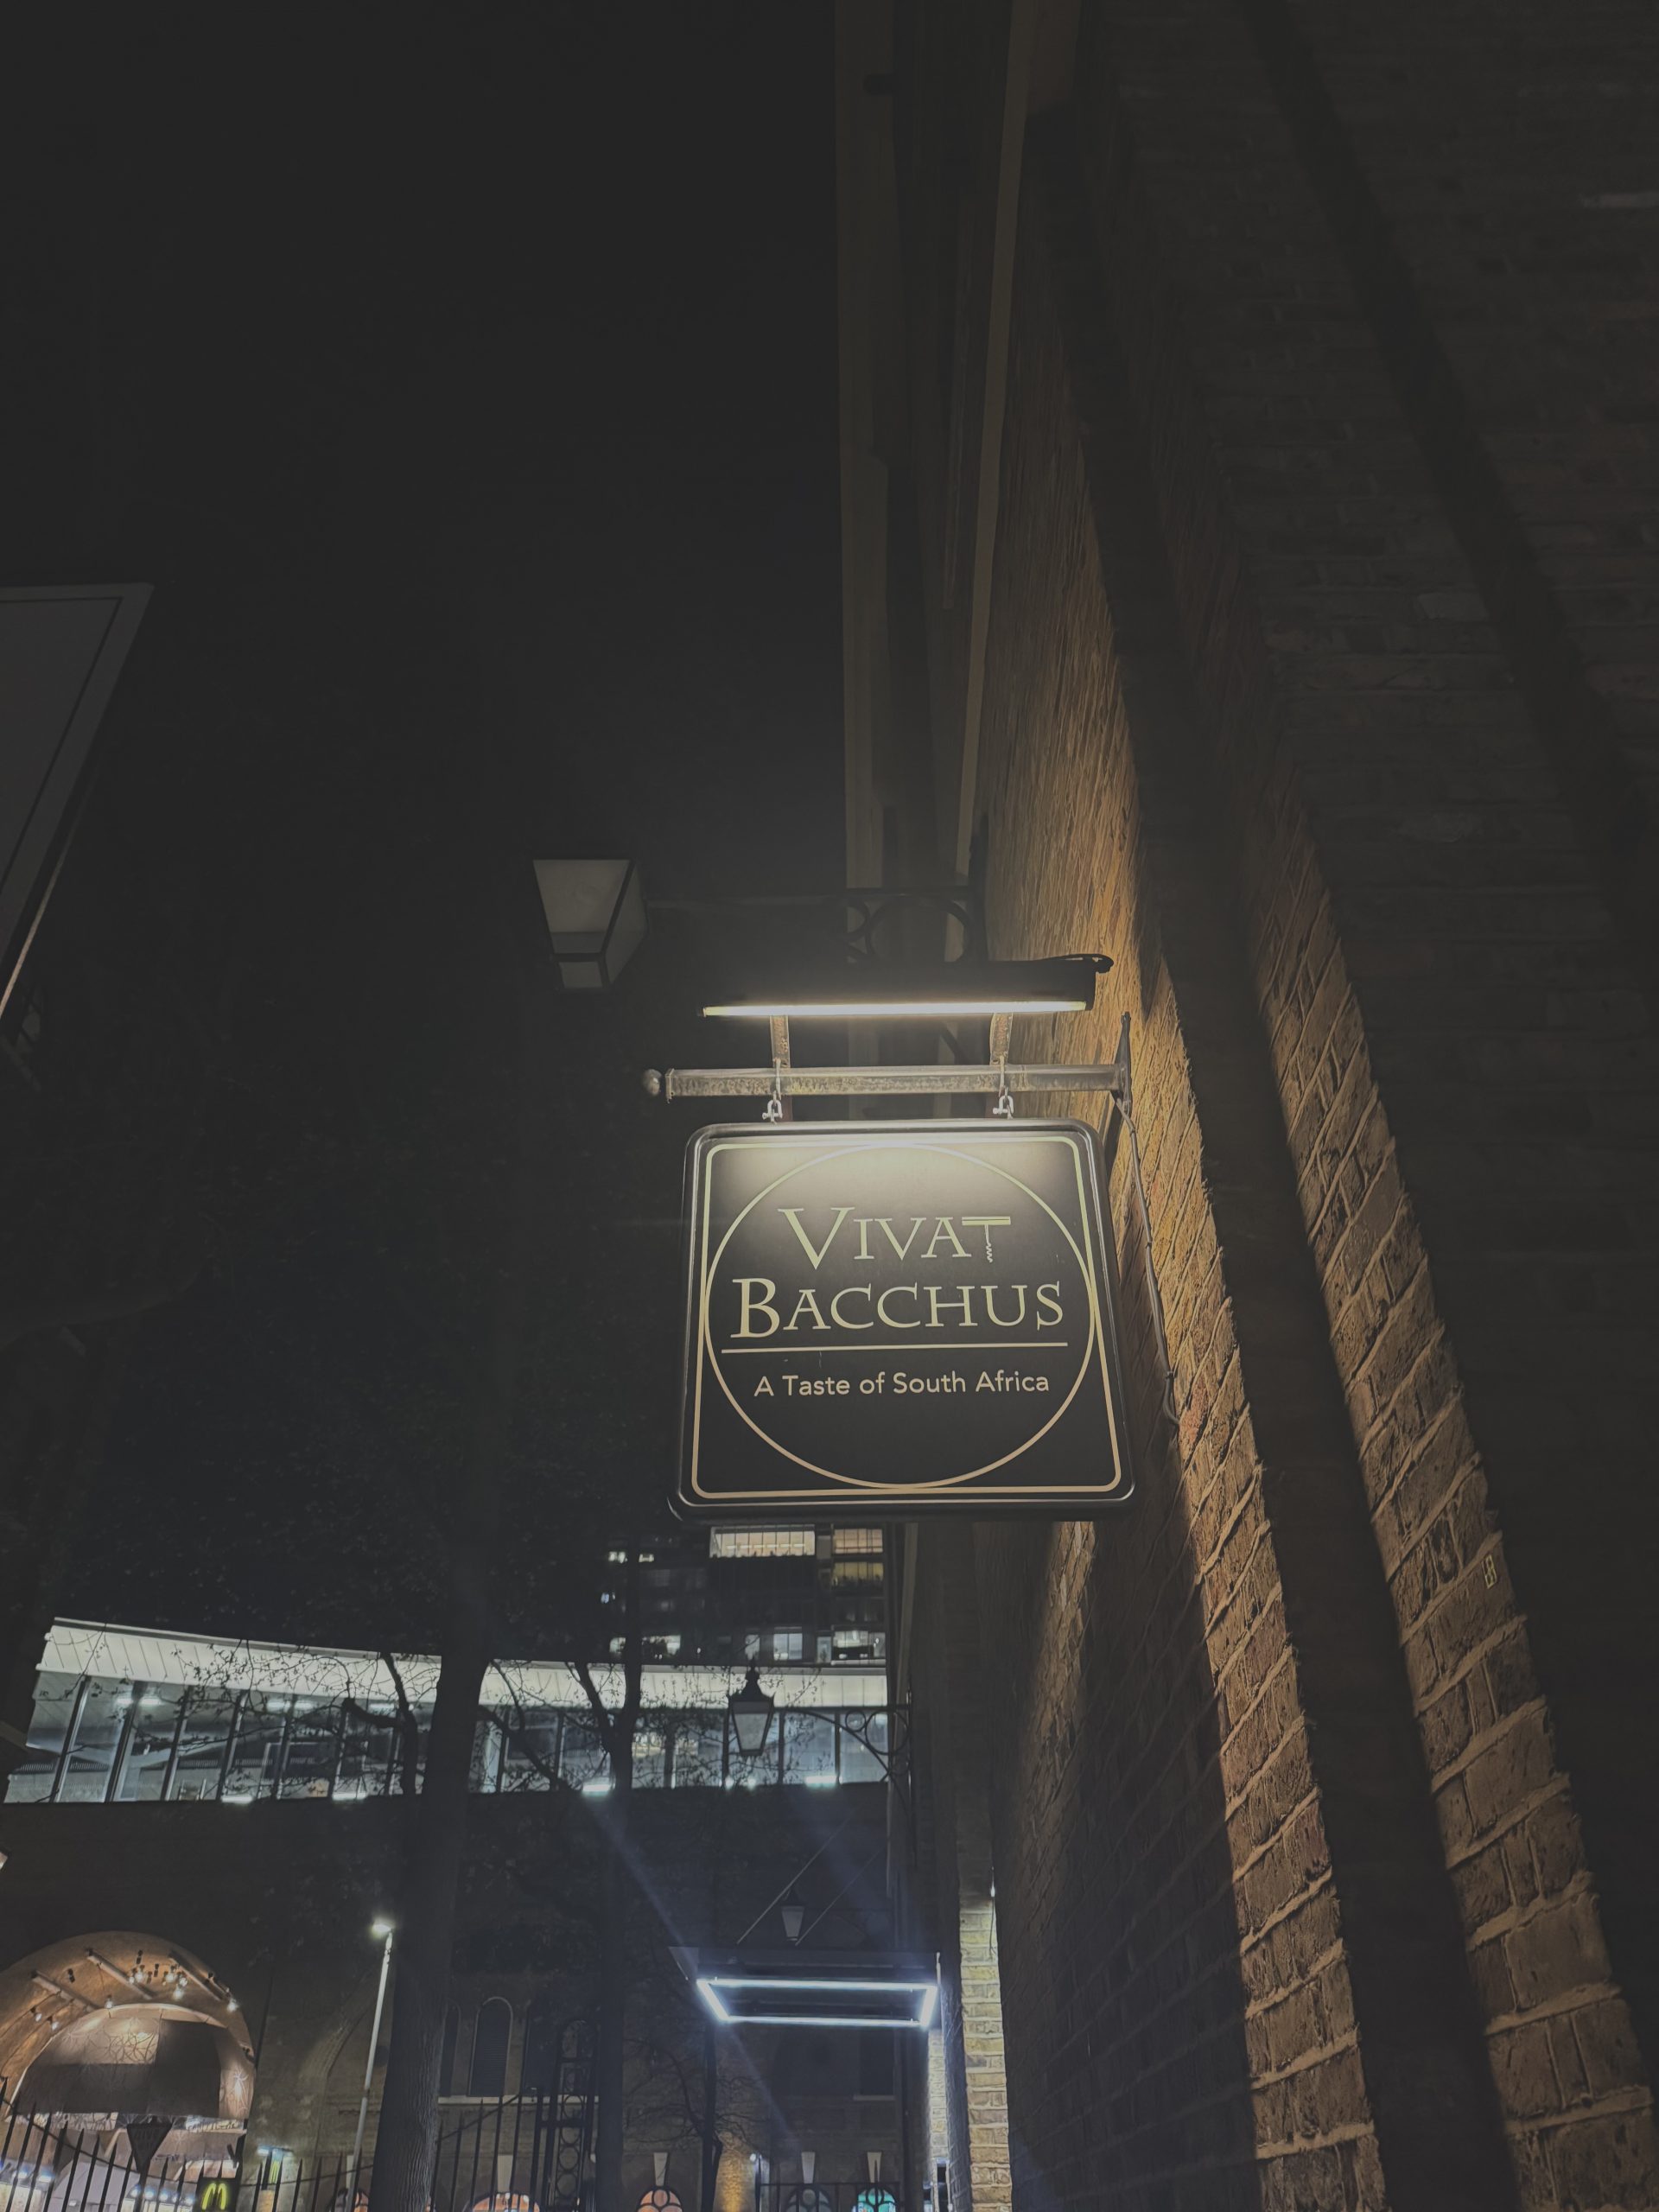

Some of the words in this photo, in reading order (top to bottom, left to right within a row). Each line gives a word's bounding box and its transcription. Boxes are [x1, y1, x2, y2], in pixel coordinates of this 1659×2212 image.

[778, 1206, 1011, 1269] VIVAT
[730, 1277, 1064, 1338] BACCHUS
[753, 1376, 774, 1397] A
[782, 1374, 851, 1396] Taste
[859, 1371, 886, 1395] of
[893, 1371, 967, 1394] South
[976, 1370, 1050, 1392] Africa
